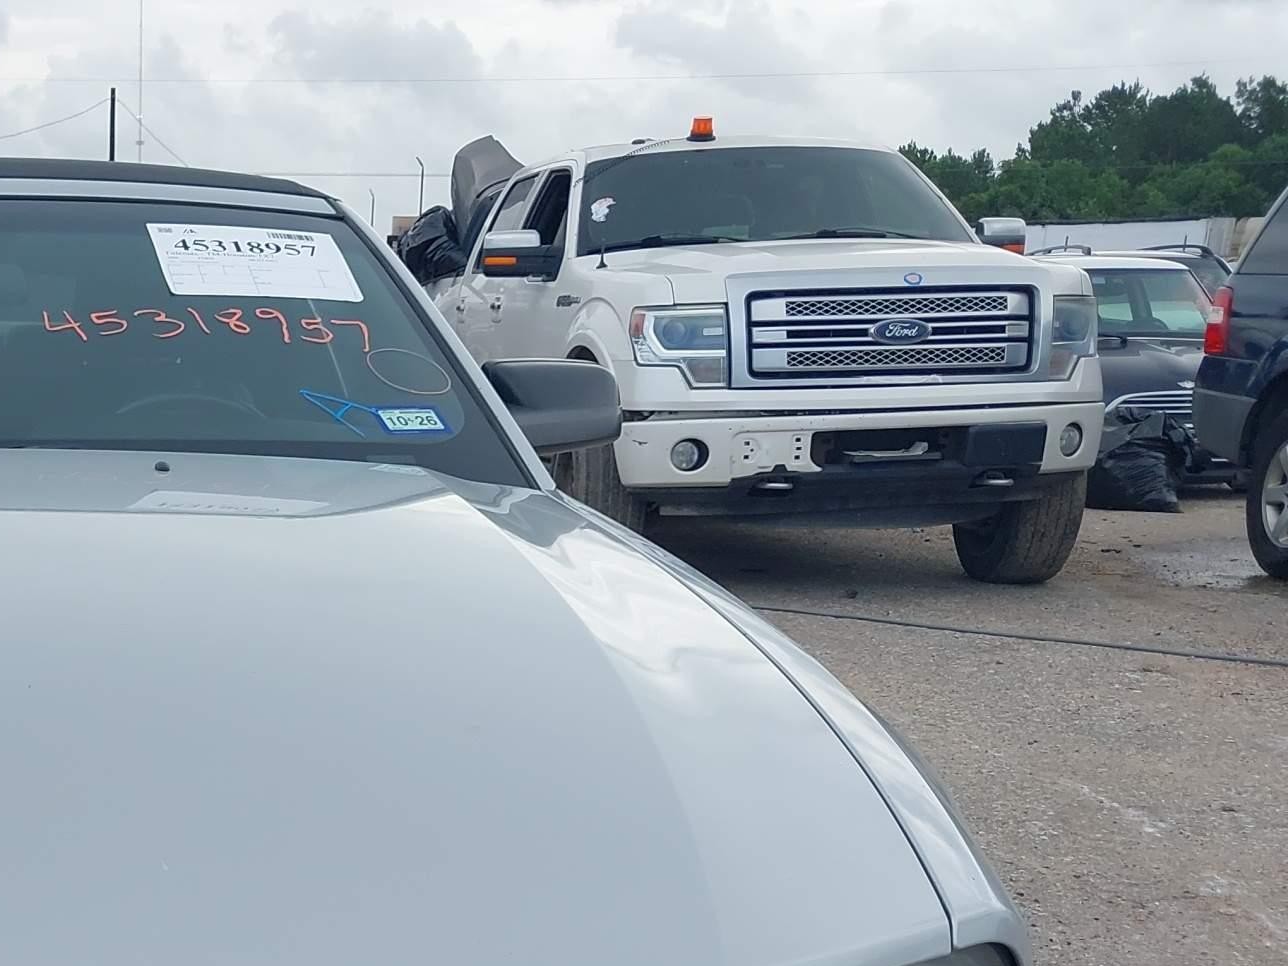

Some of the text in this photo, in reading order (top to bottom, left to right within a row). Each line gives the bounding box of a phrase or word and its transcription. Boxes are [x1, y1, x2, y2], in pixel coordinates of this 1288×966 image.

[173, 238, 317, 258] 45318957
[42, 307, 370, 352] 45318957
[885, 322, 919, 337] Ford
